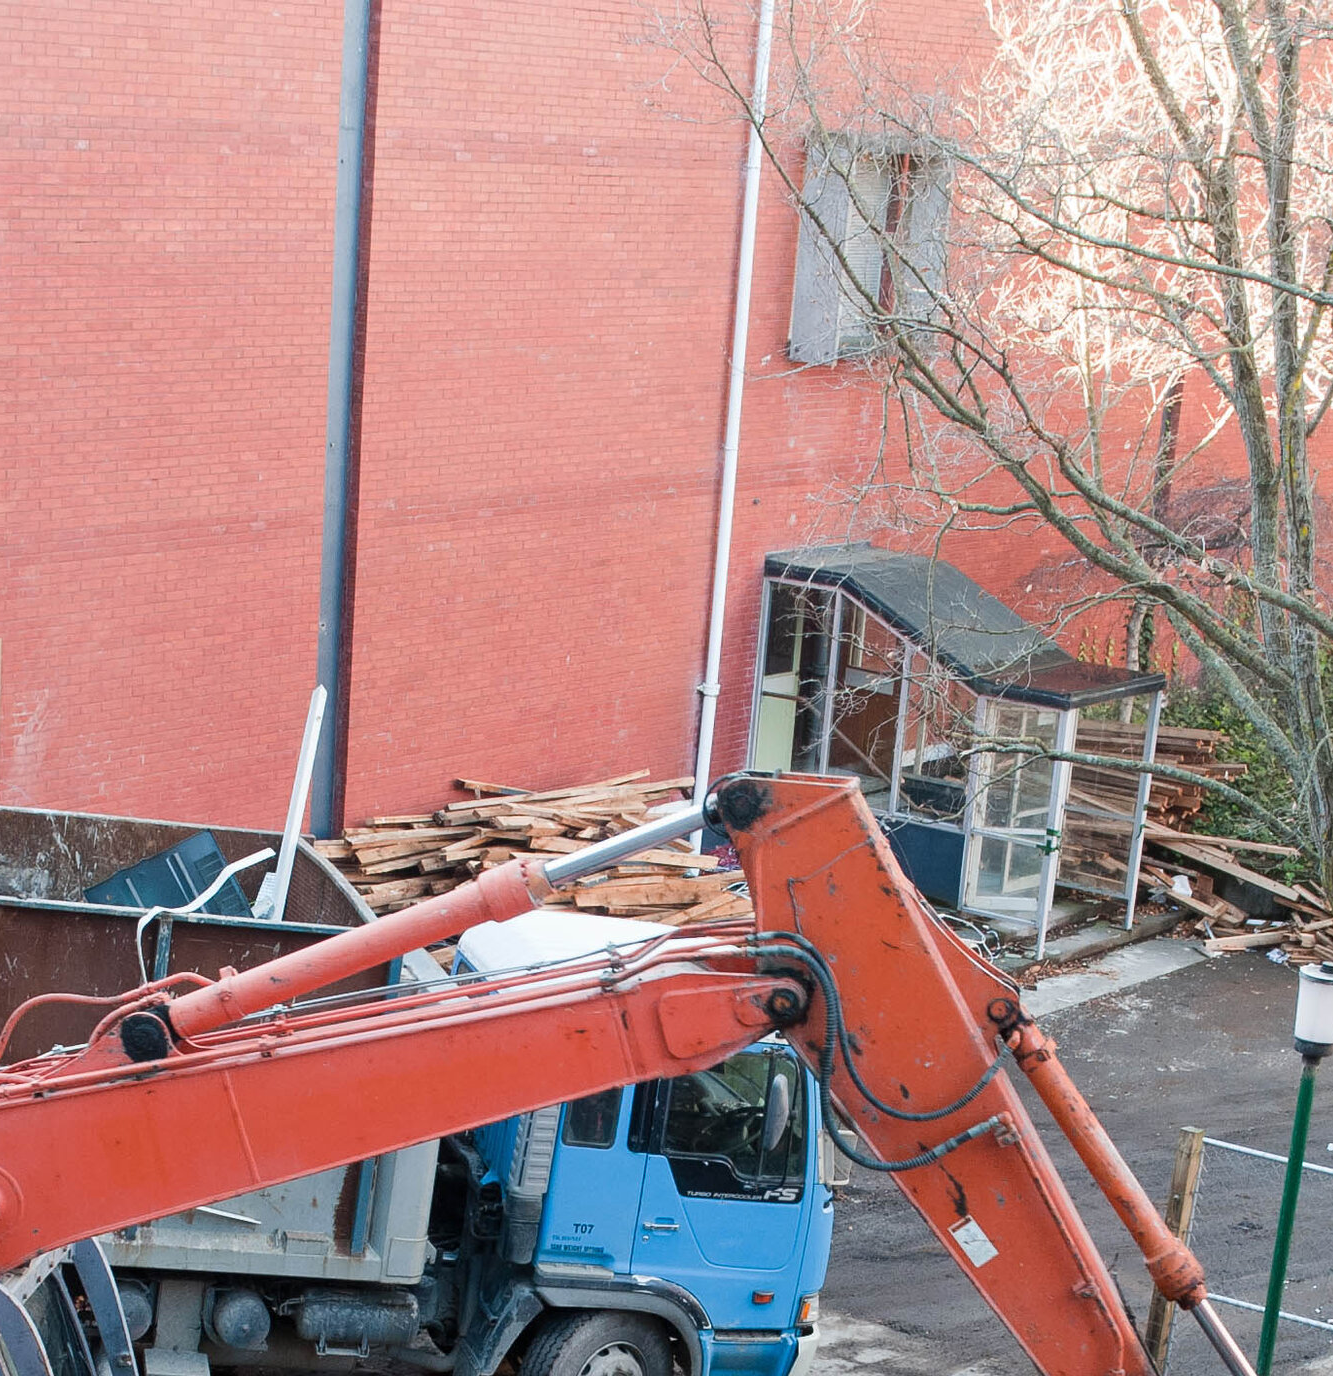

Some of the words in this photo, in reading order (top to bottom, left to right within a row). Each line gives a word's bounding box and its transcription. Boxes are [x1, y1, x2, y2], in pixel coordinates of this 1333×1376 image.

[686, 1190, 711, 1198] TURBO
[763, 1187, 800, 1201] FS
[573, 1223, 595, 1234] T07
